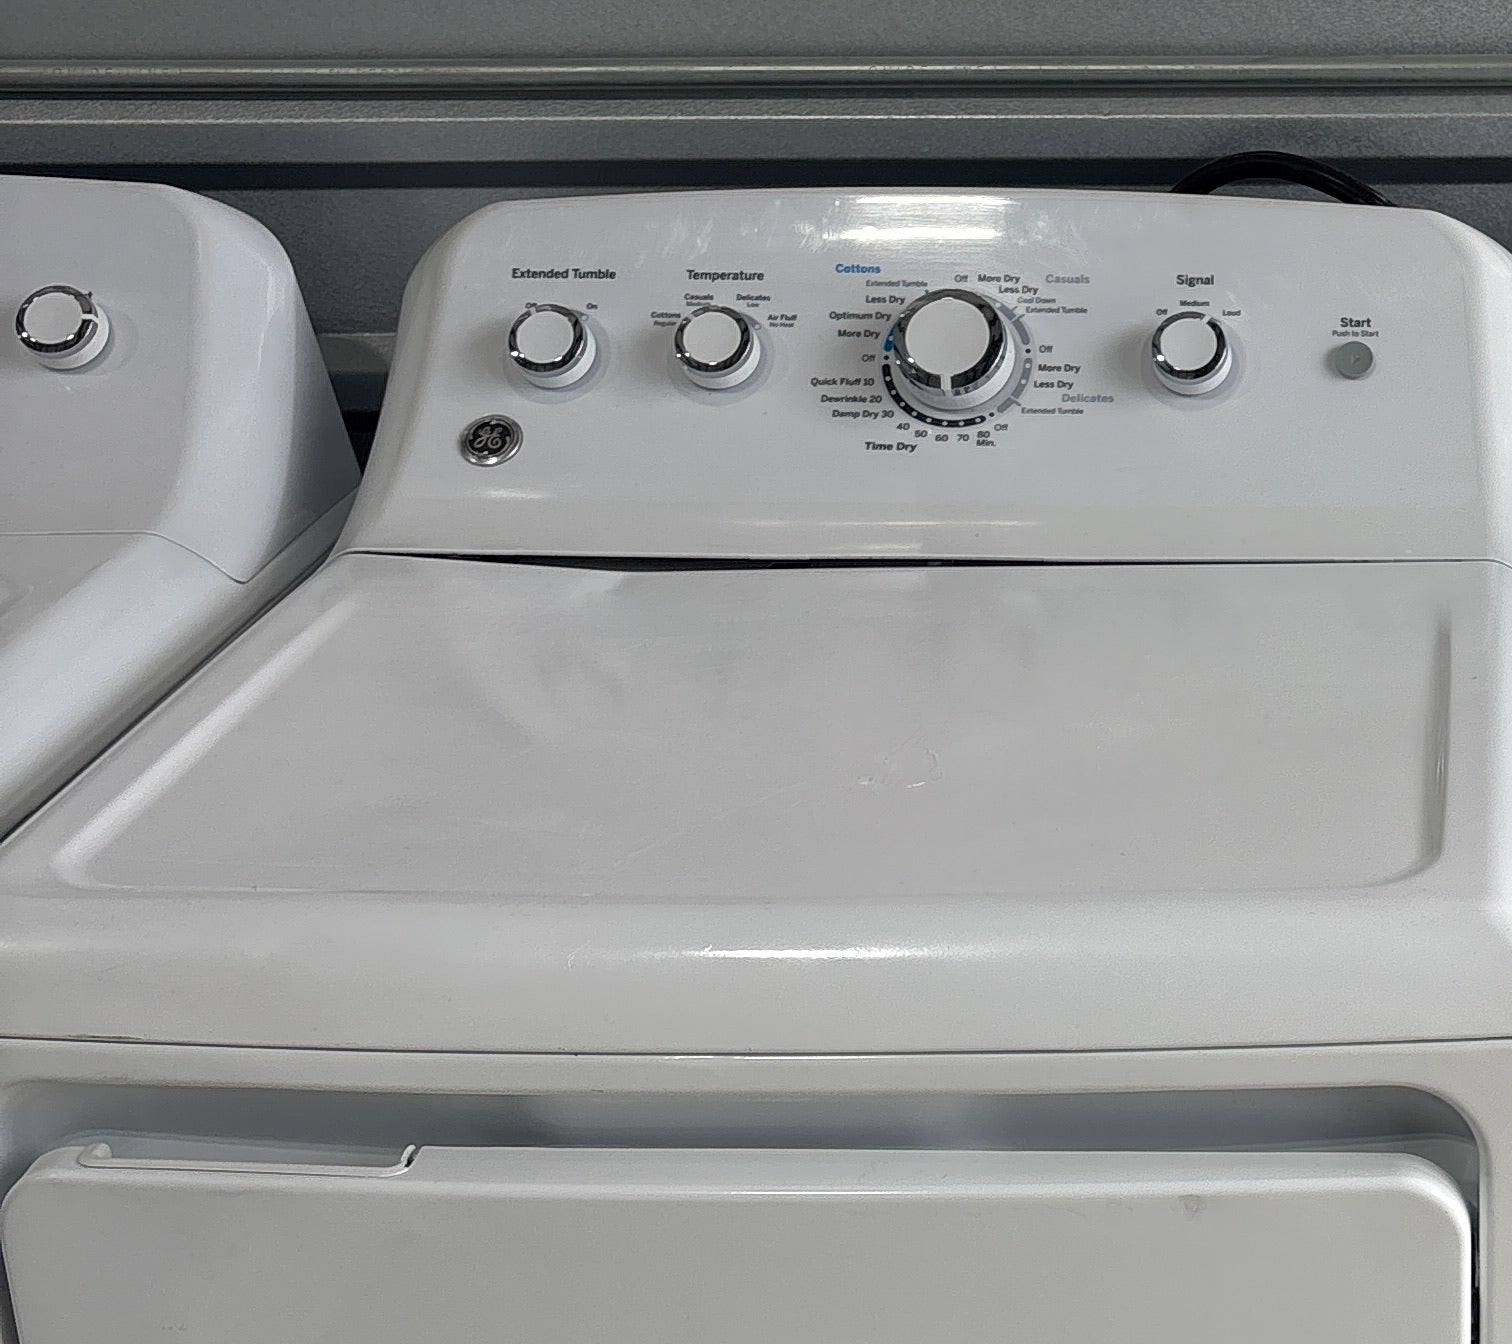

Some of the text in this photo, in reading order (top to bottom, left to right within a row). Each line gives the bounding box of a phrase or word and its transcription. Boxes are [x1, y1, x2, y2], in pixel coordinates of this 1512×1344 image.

[511, 267, 617, 280] Extended Tumble
[835, 263, 882, 274] Cottons
[686, 269, 765, 283] Temperature
[977, 273, 1021, 285] More Dry
[1044, 273, 1091, 284] Casuals
[1176, 274, 1215, 288] Signal
[998, 285, 1039, 296] Less Dry
[828, 310, 892, 322] Optimum Dry
[1340, 316, 1372, 328] Start
[837, 329, 881, 340] More Dry
[1061, 393, 1115, 404] Delicates
[831, 409, 895, 420] Damp Dry 30
[864, 441, 918, 453] Time Dry
